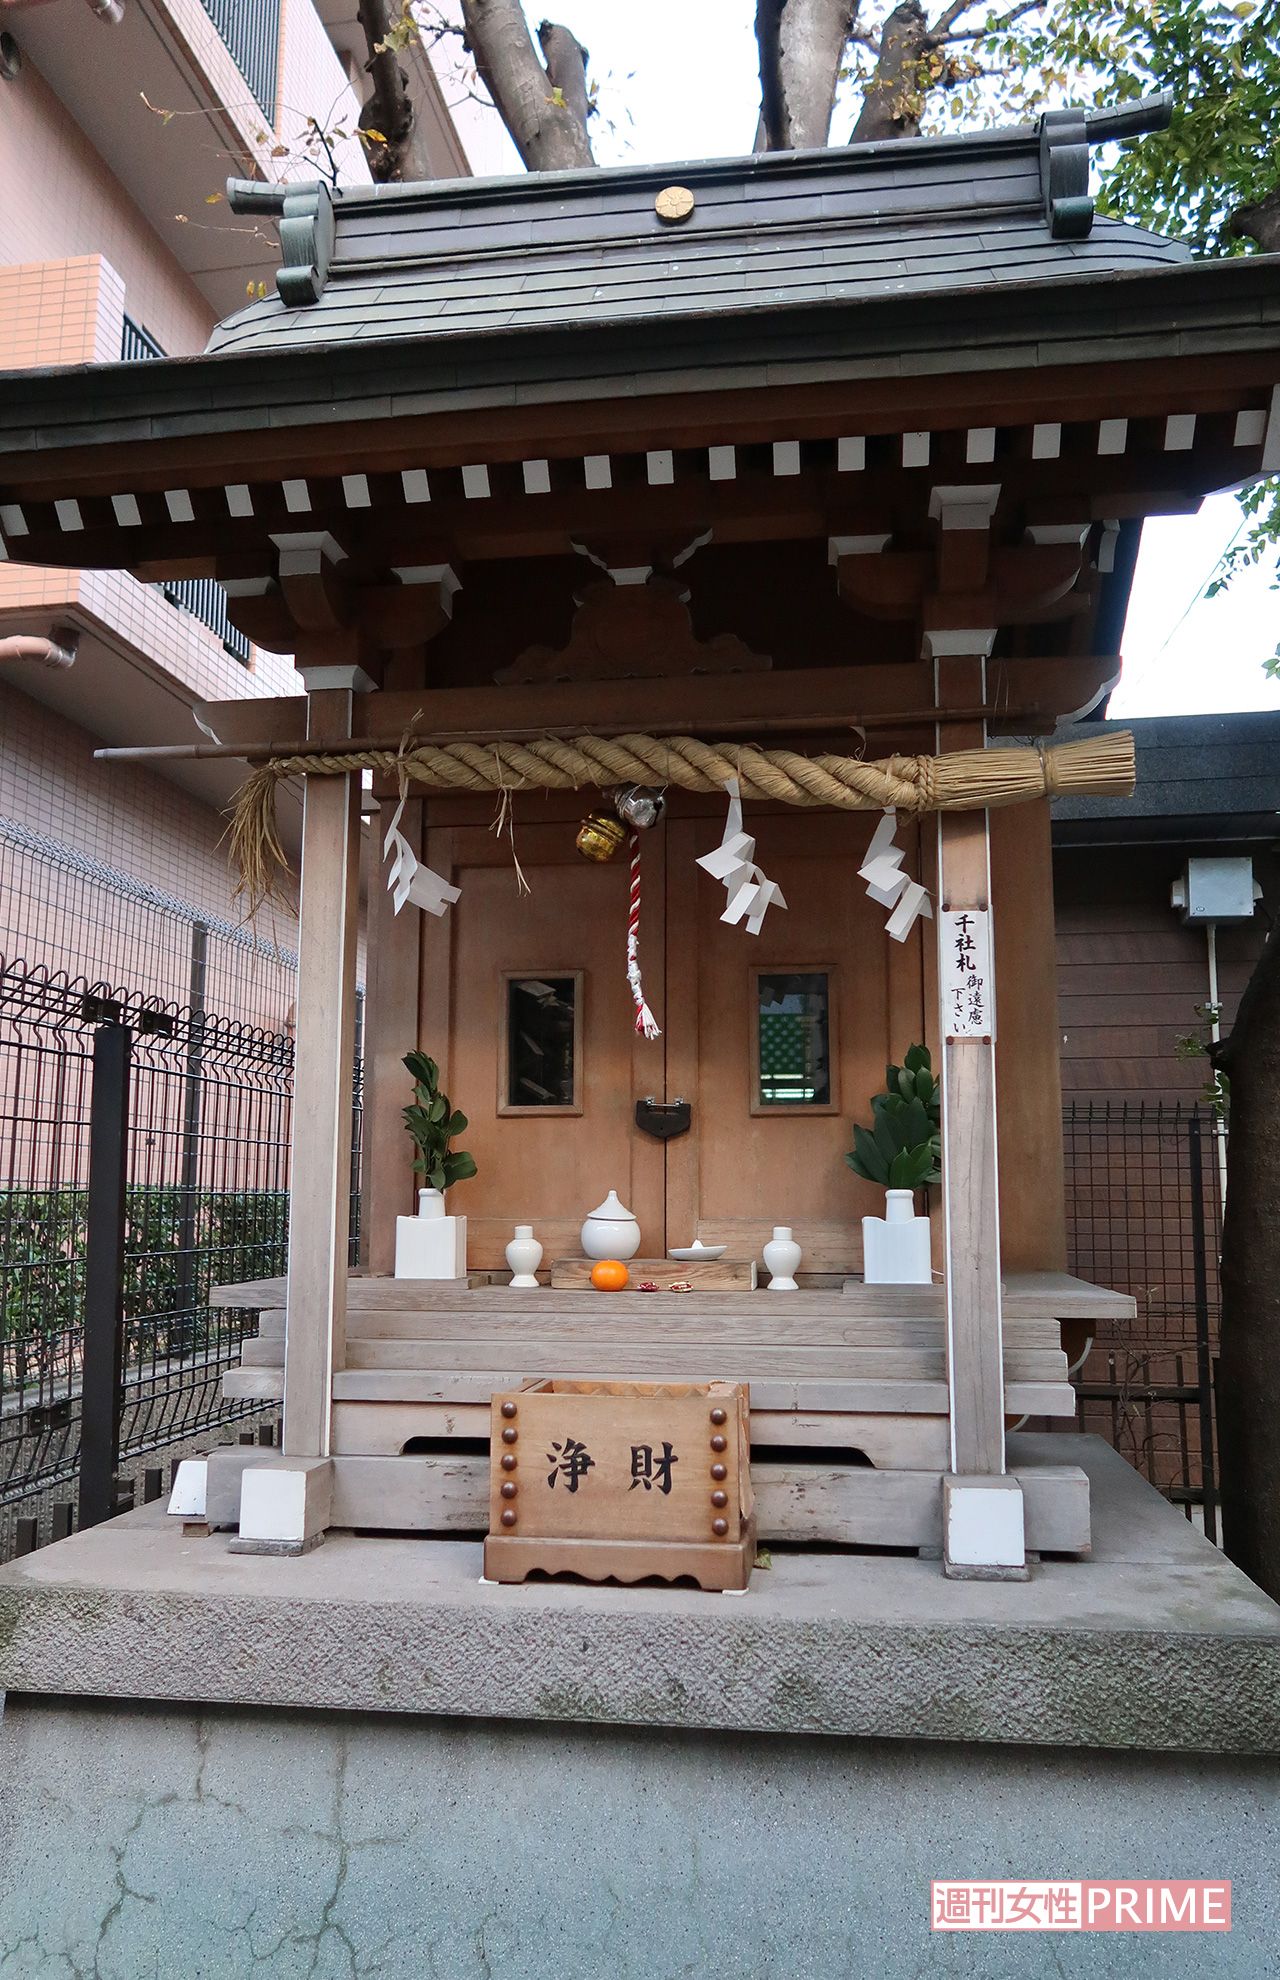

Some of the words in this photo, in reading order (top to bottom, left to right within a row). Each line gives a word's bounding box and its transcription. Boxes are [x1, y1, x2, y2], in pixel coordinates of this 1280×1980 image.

[955, 914, 976, 972] 千社札
[951, 987, 966, 1033] 下さい
[967, 974, 984, 1025] 御遠慮
